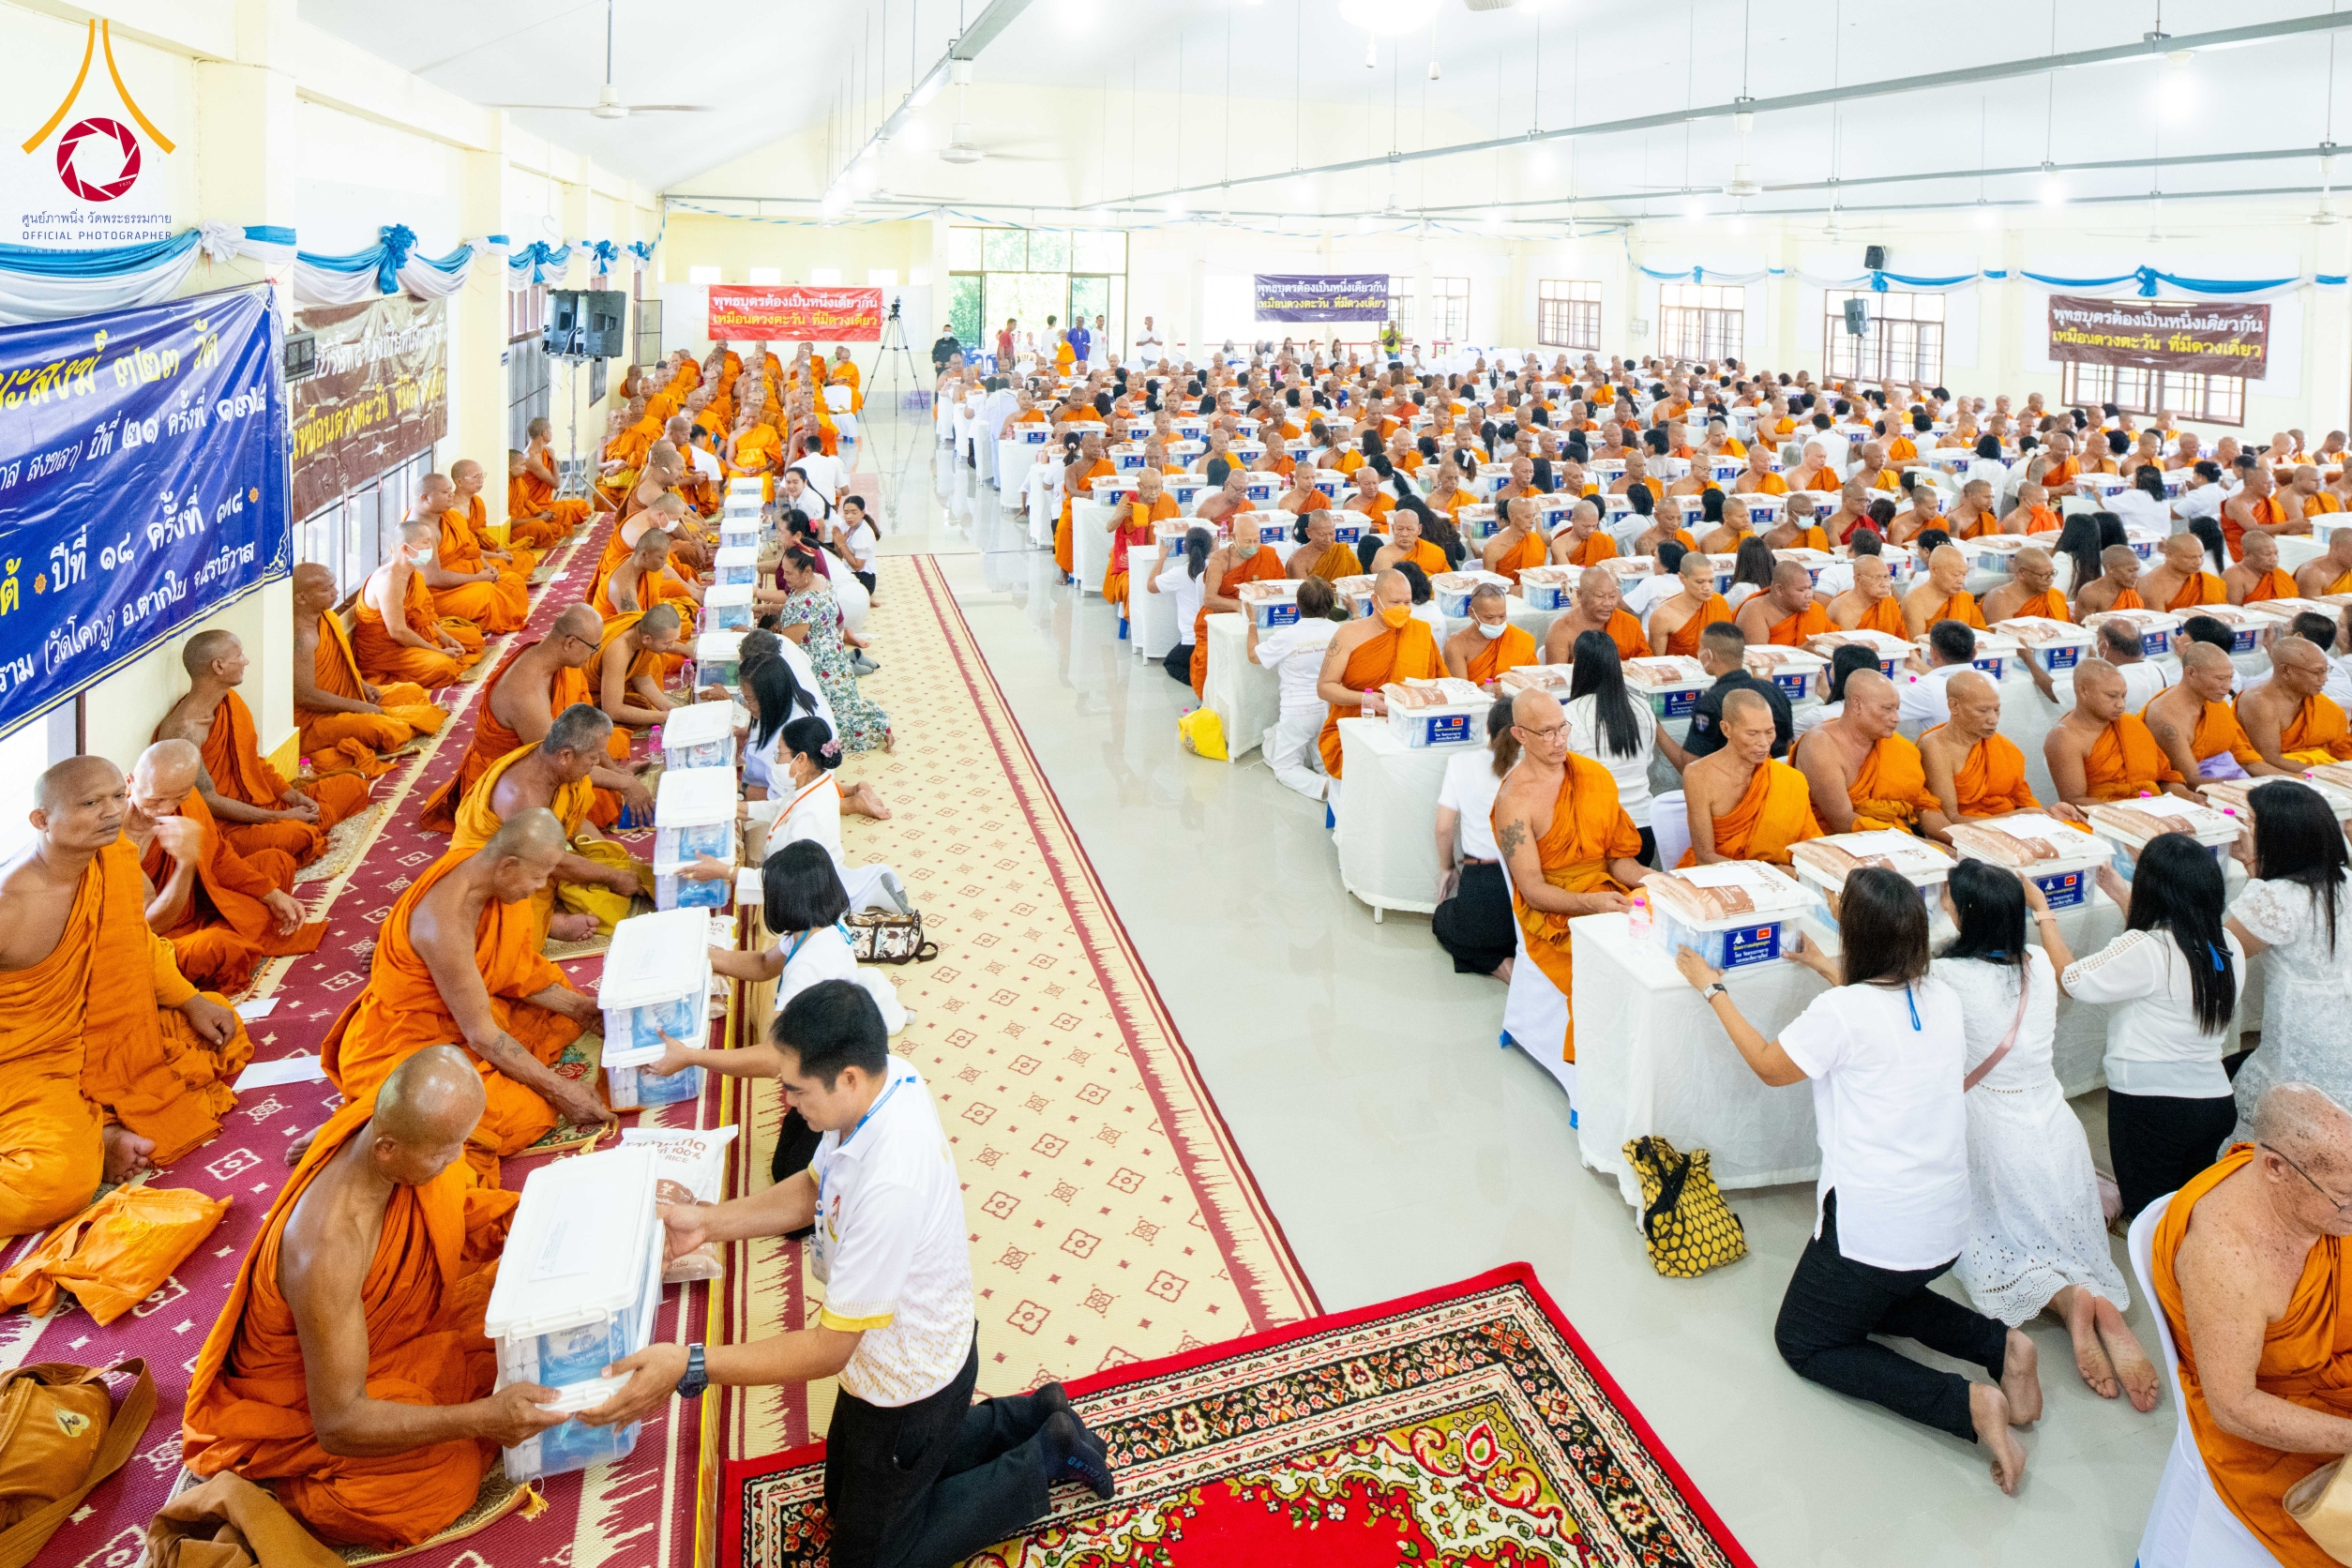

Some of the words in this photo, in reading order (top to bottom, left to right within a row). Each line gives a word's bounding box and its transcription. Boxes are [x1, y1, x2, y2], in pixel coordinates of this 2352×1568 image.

[713, 292, 878, 311] พุทธบุตรต้องเป็นหนึ่งเดียวกัน
[1257, 296, 1330, 309] เหมือนดวงตะวัน
[1334, 294, 1386, 309] ที่มีดวงเดียว
[713, 309, 806, 326] เหมือนดวงตะวัน
[811, 309, 878, 326] ที่มีดวงเดียว
[2052, 307, 2264, 333] พุทธบุตรต้องเป็นหนึ่งเดียวกัน
[113, 346, 180, 389] ๓๒๓
[192, 318, 219, 370] วัด
[2052, 326, 2161, 352] เหมือนดวงตะวัน
[2167, 332, 2262, 358] ที่มีดวงเดียว
[86, 410, 122, 461] ปีที่
[122, 416, 159, 449] ๒๑
[168, 388, 208, 437] ครั้งที่
[50, 524, 88, 594] ปีที่
[99, 533, 135, 570] ๑๘
[146, 485, 205, 551] ครั้งที่
[122, 569, 188, 627] อ.ตากใบ
[193, 541, 255, 590] จ.นราธิวาส
[664, 1154, 689, 1164] RICE
[671, 1147, 701, 1160] 100%
